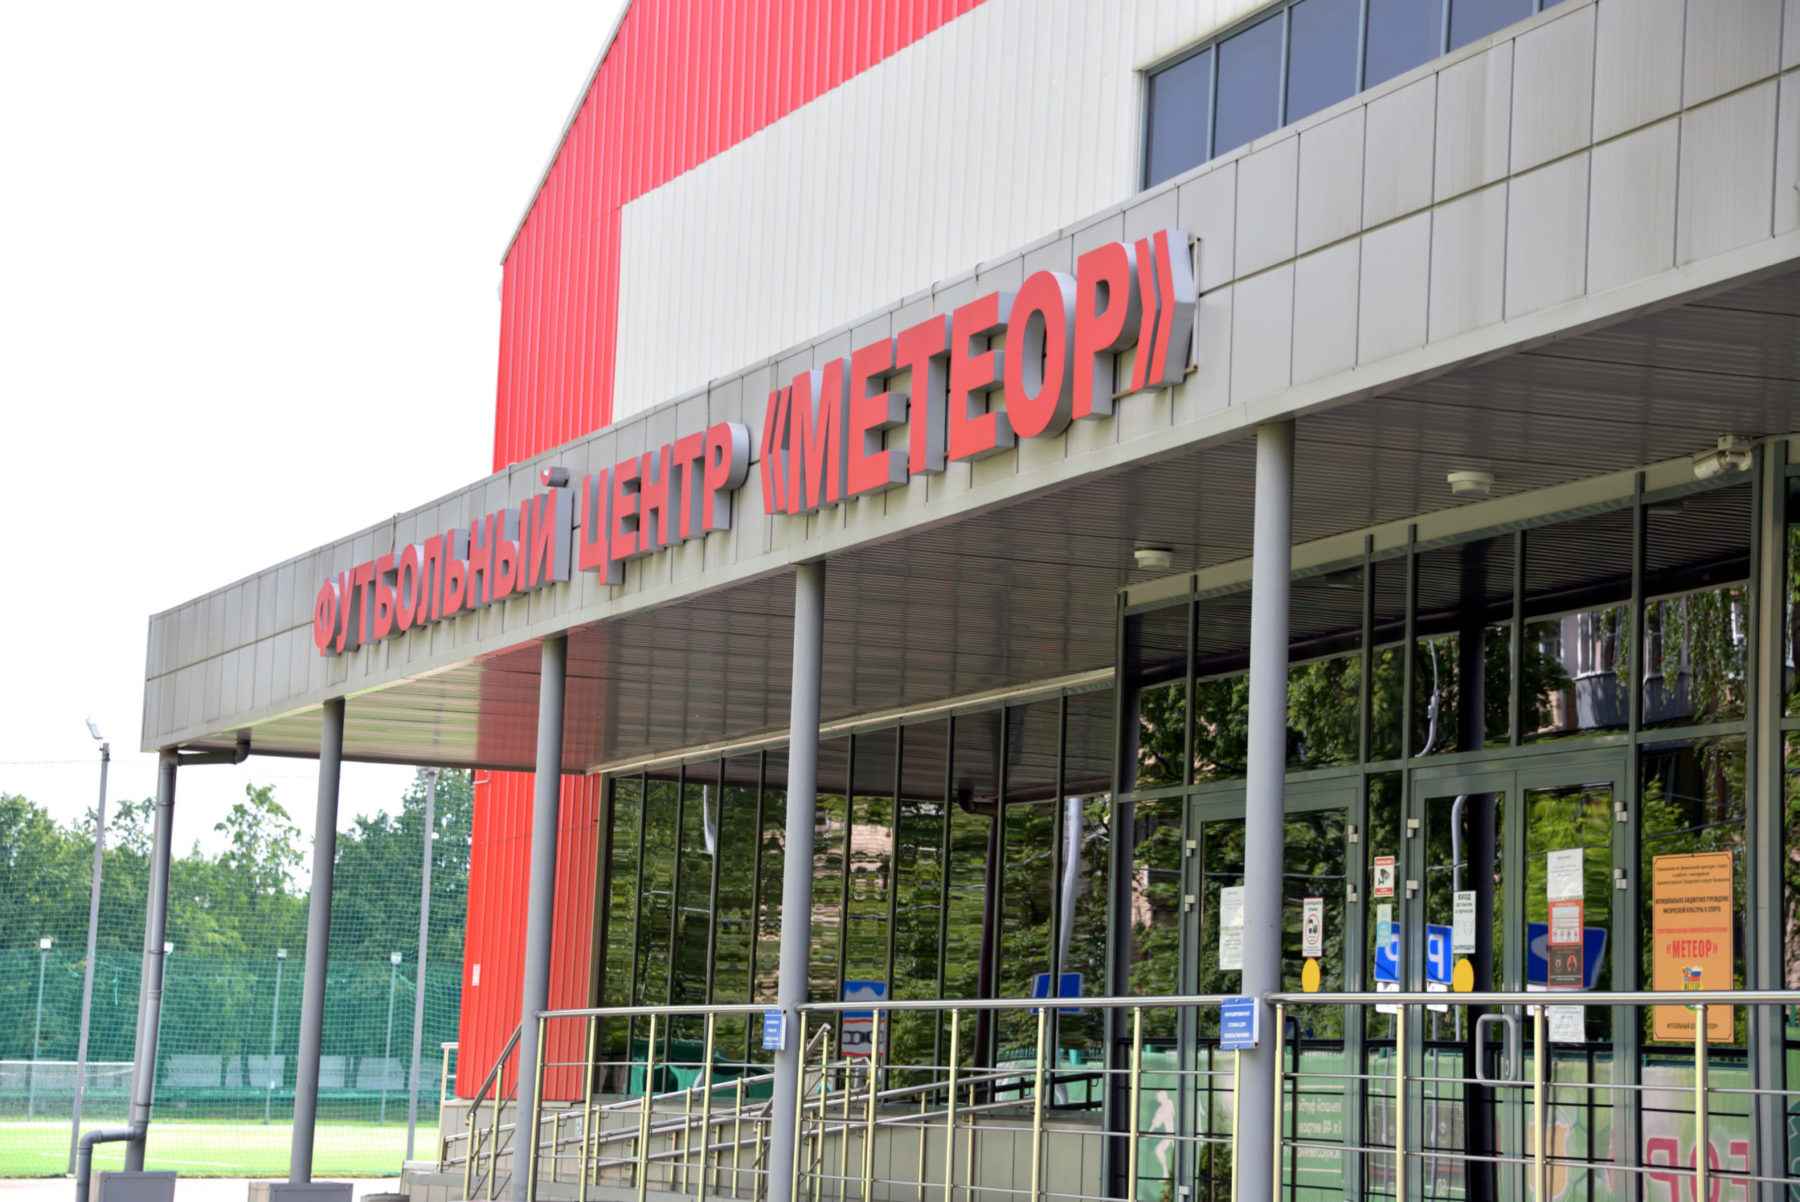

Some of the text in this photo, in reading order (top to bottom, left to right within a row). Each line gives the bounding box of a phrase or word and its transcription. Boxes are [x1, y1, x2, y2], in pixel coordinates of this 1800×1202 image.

[313, 228, 1195, 657] ФУТБОЛЬНЫЙ ЦЕНТР «МЕТЕОР»
[1666, 939, 1718, 958] «МЕТЕОР»
